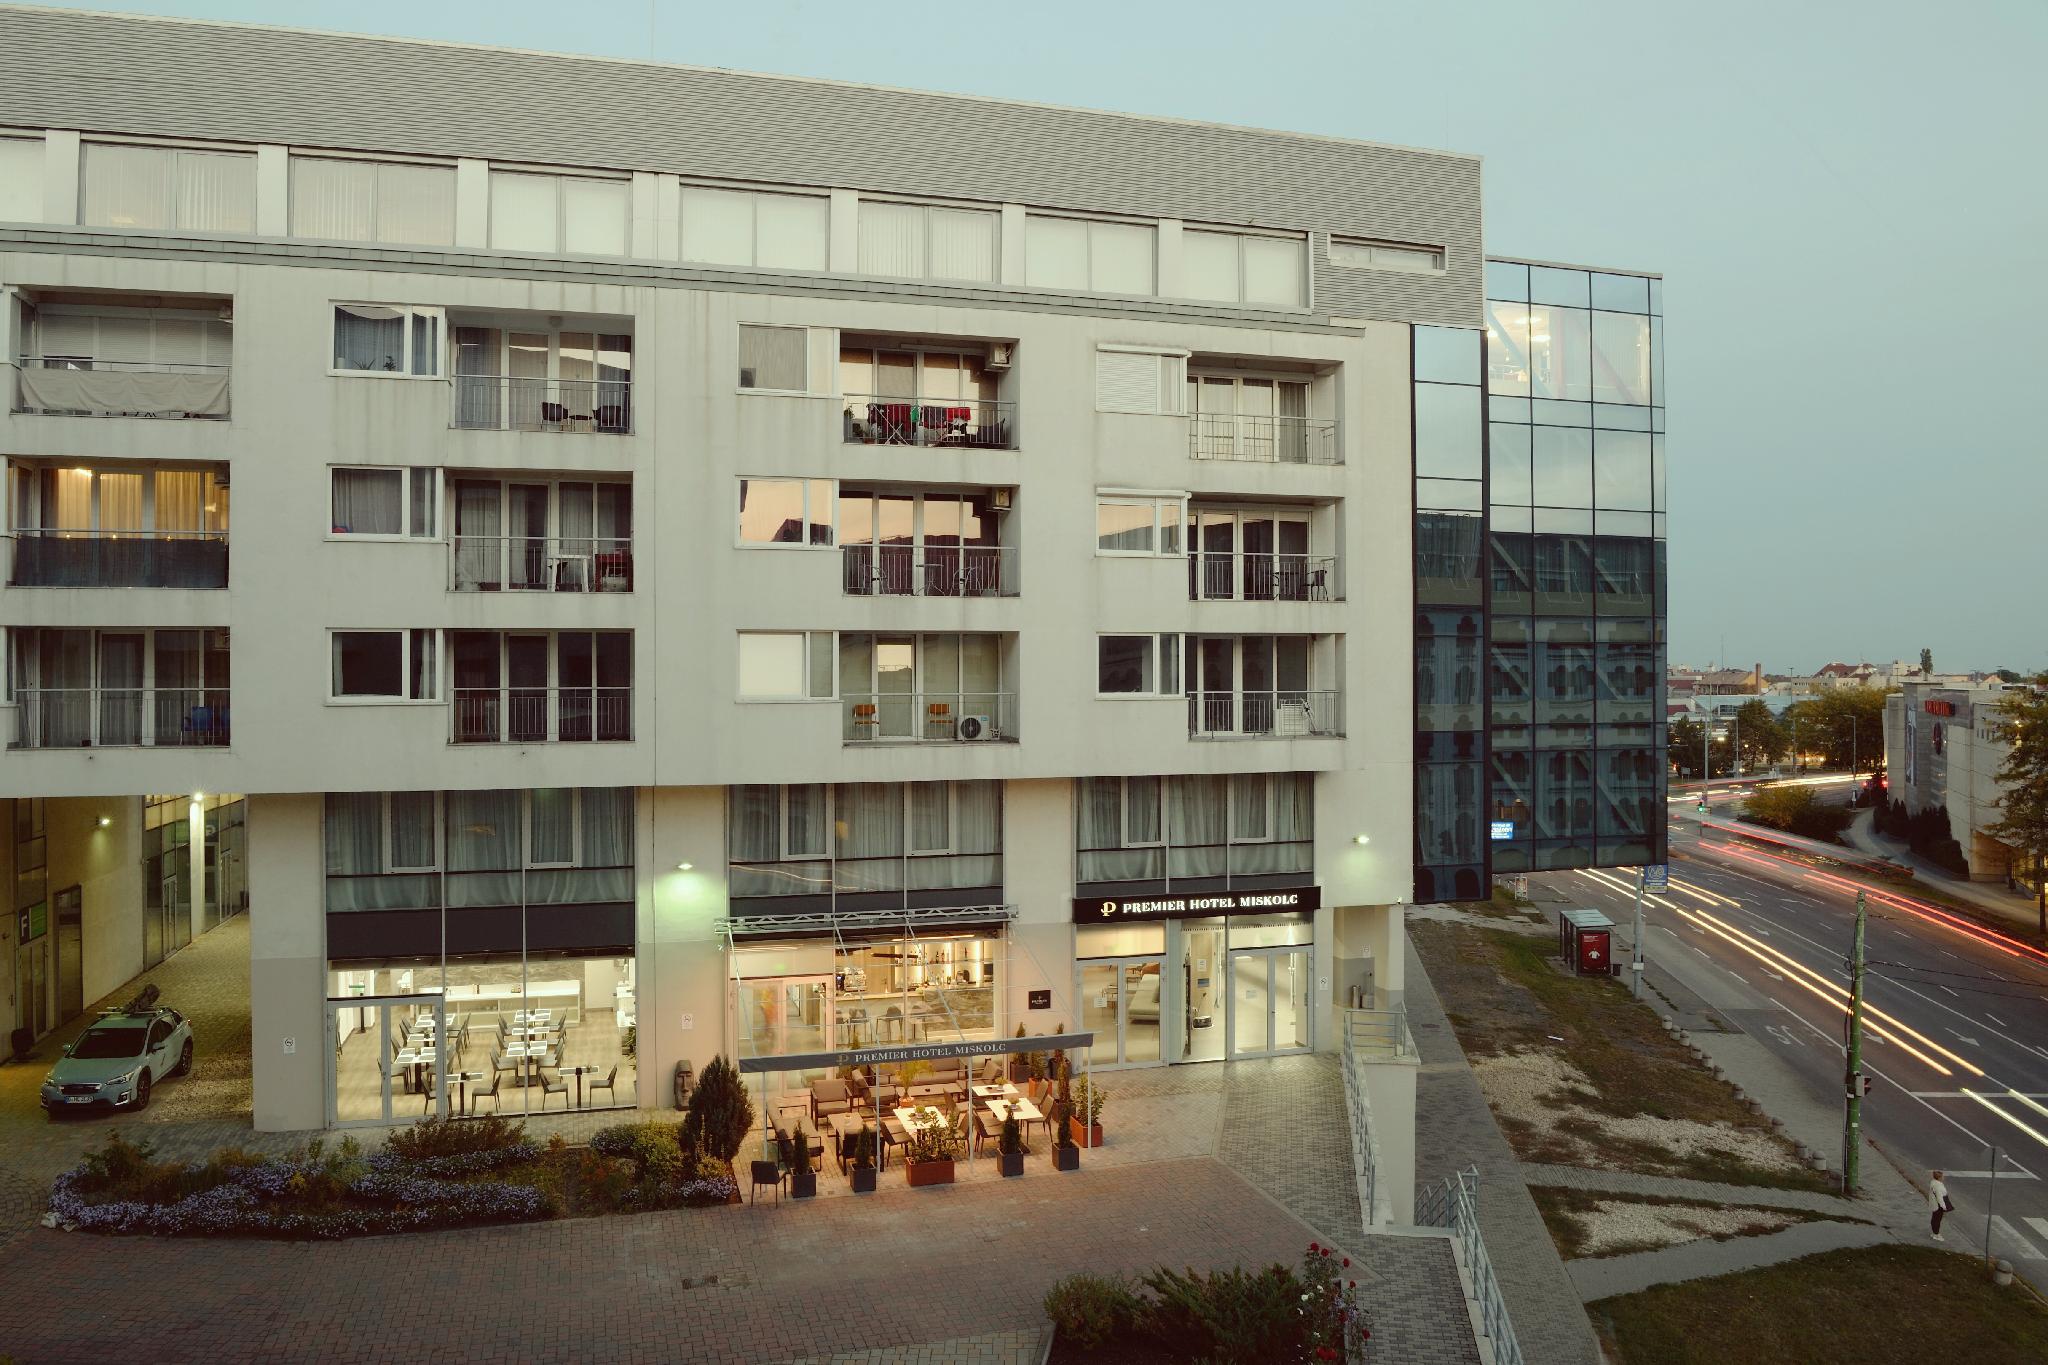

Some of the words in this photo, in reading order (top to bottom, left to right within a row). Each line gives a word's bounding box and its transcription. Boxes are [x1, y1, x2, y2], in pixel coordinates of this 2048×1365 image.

[1122, 900, 1185, 914] PREMIER
[1190, 898, 1235, 911] HOTEL
[1239, 895, 1298, 907] MISKOLC
[854, 1051, 908, 1062] PREMIER
[912, 1047, 952, 1059] HOTEL
[955, 1044, 1007, 1055] MISKOLC
